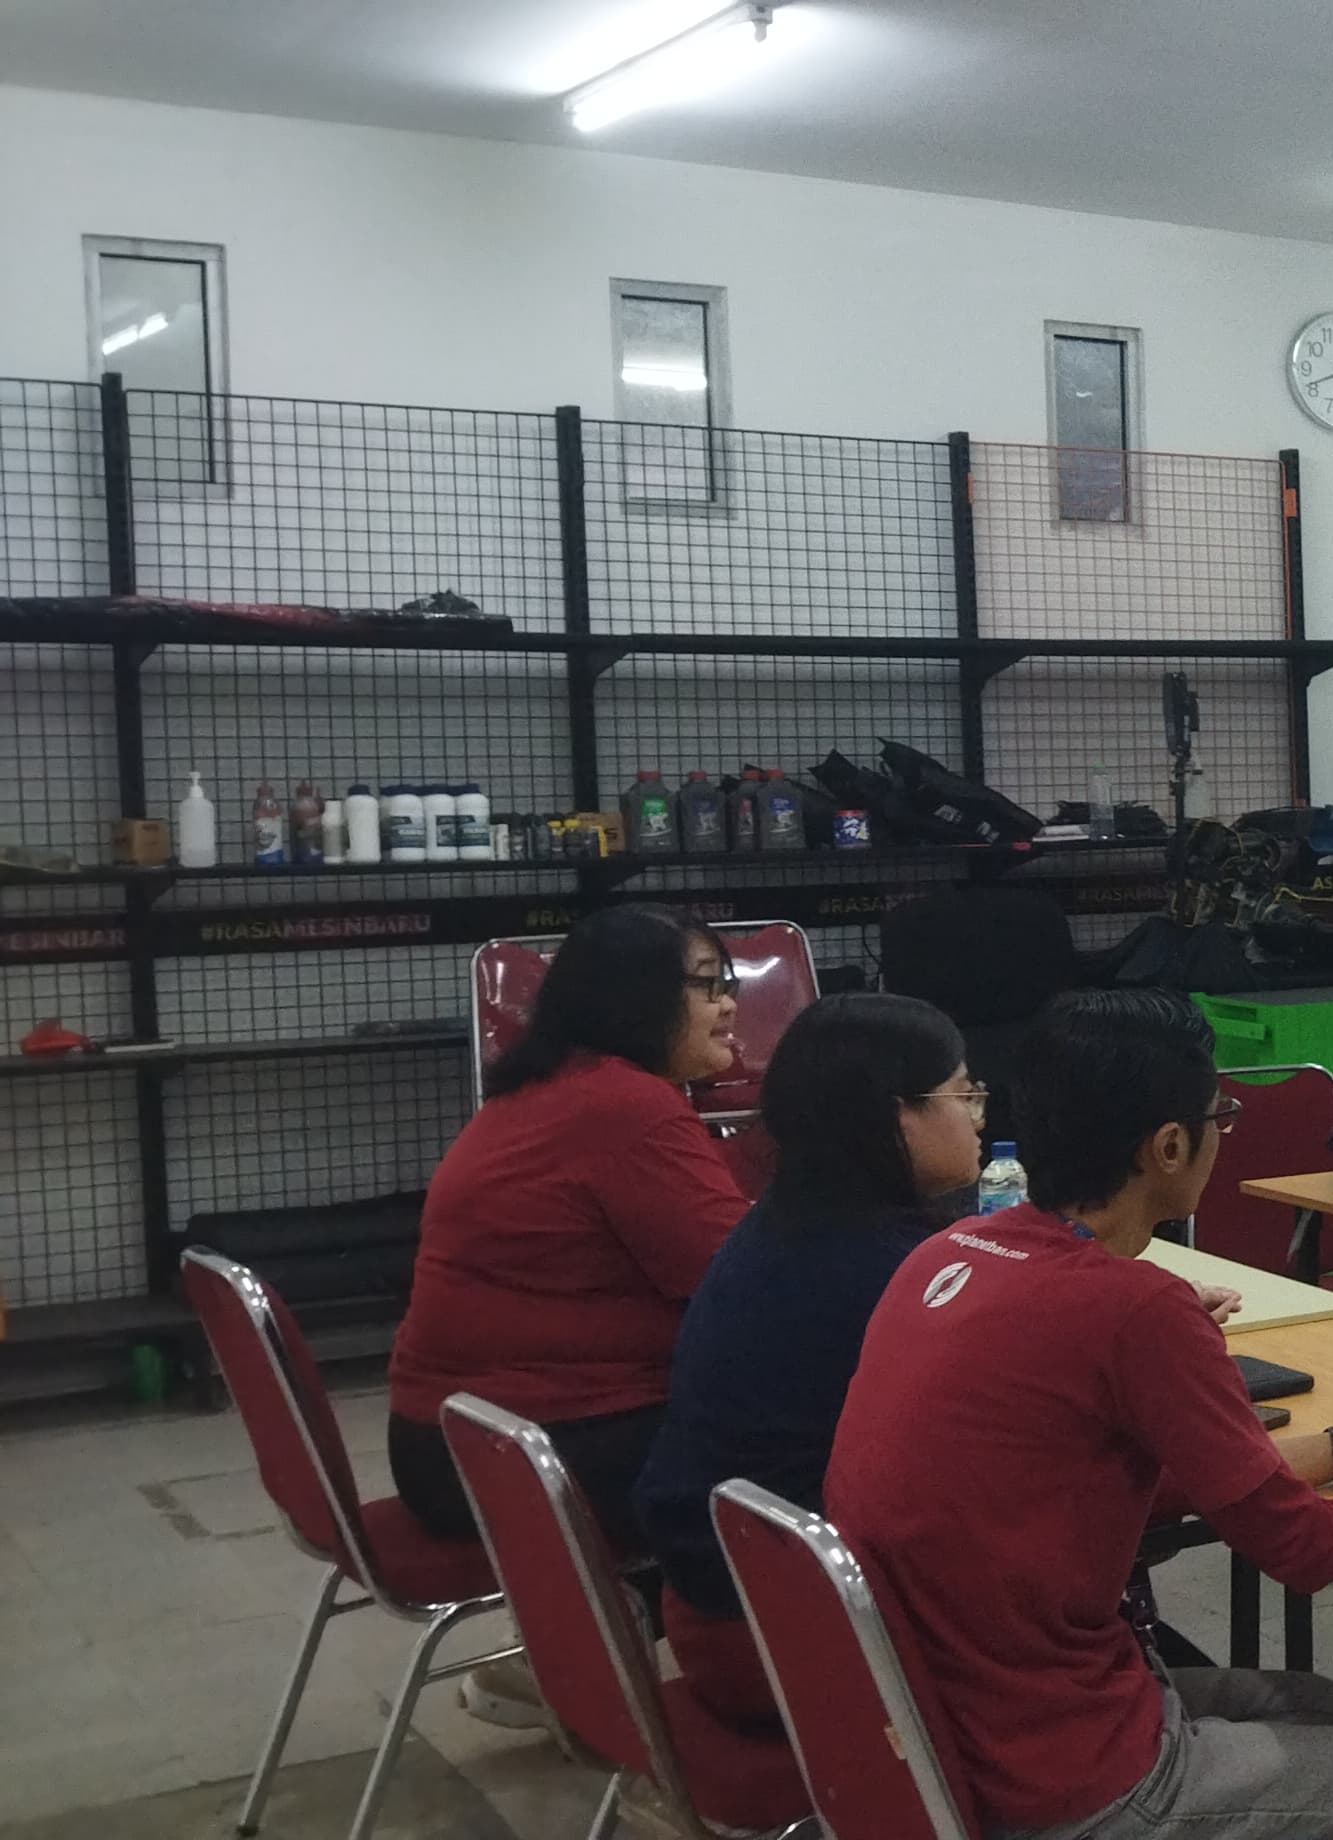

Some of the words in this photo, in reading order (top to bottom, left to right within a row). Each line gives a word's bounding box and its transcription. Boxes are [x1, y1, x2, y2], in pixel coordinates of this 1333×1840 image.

[1322, 327, 1332, 344] 11
[1308, 341, 1323, 358] 10
[1300, 360, 1312, 377] 9
[1308, 383, 1319, 398] 8
[1325, 397, 1333, 414] 7
